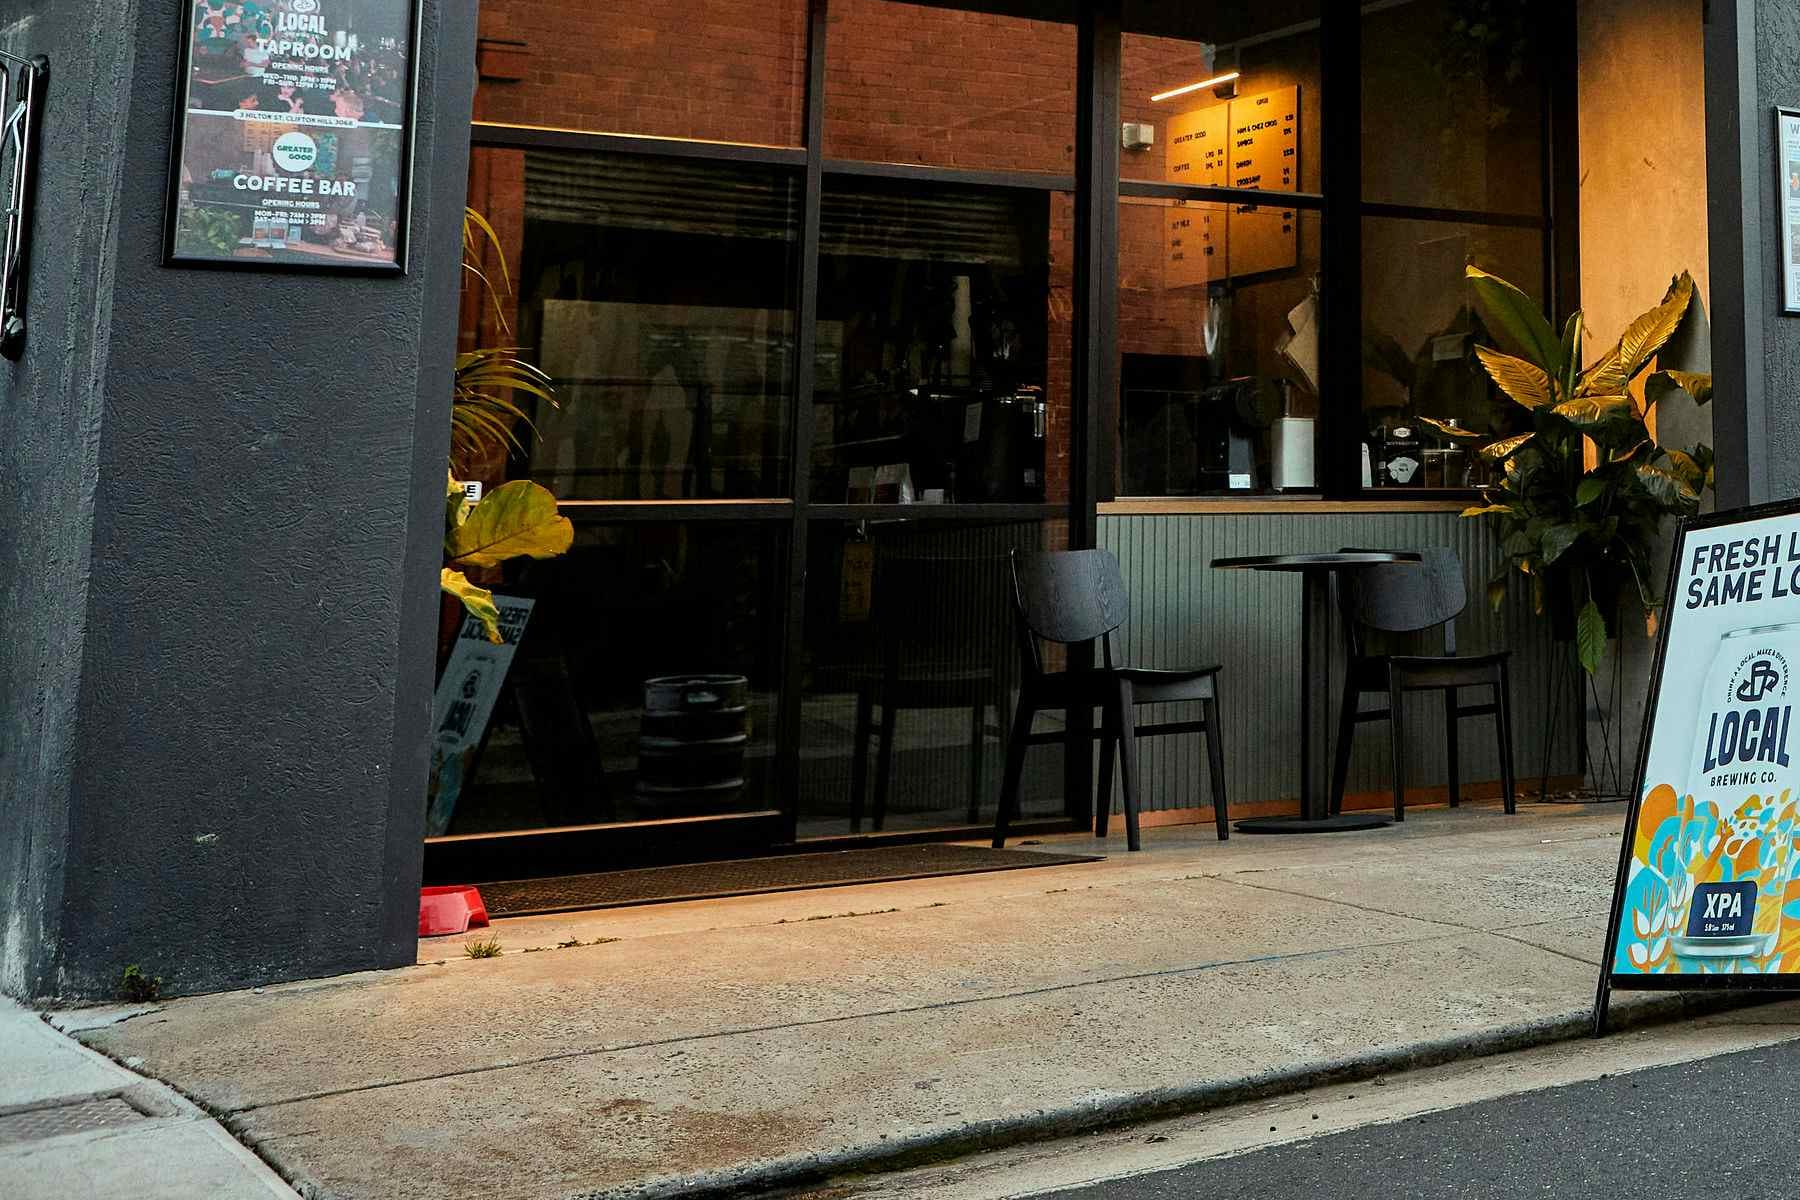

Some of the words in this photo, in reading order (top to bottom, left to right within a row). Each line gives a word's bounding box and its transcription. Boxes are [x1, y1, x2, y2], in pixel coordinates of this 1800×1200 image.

[278, 12, 328, 36] LOCAL
[256, 38, 352, 61] TAPROOM
[277, 144, 313, 154] GREATER
[288, 153, 313, 161] GOOD
[233, 174, 314, 194] COFFEE
[319, 179, 356, 196] BAR
[1690, 533, 1782, 576] FRESH
[1685, 569, 1767, 610] SAME
[1703, 705, 1791, 775] LOCAL
[1710, 772, 1757, 787] BREWING
[1760, 771, 1777, 784] CO.
[1702, 892, 1742, 919] XPA
